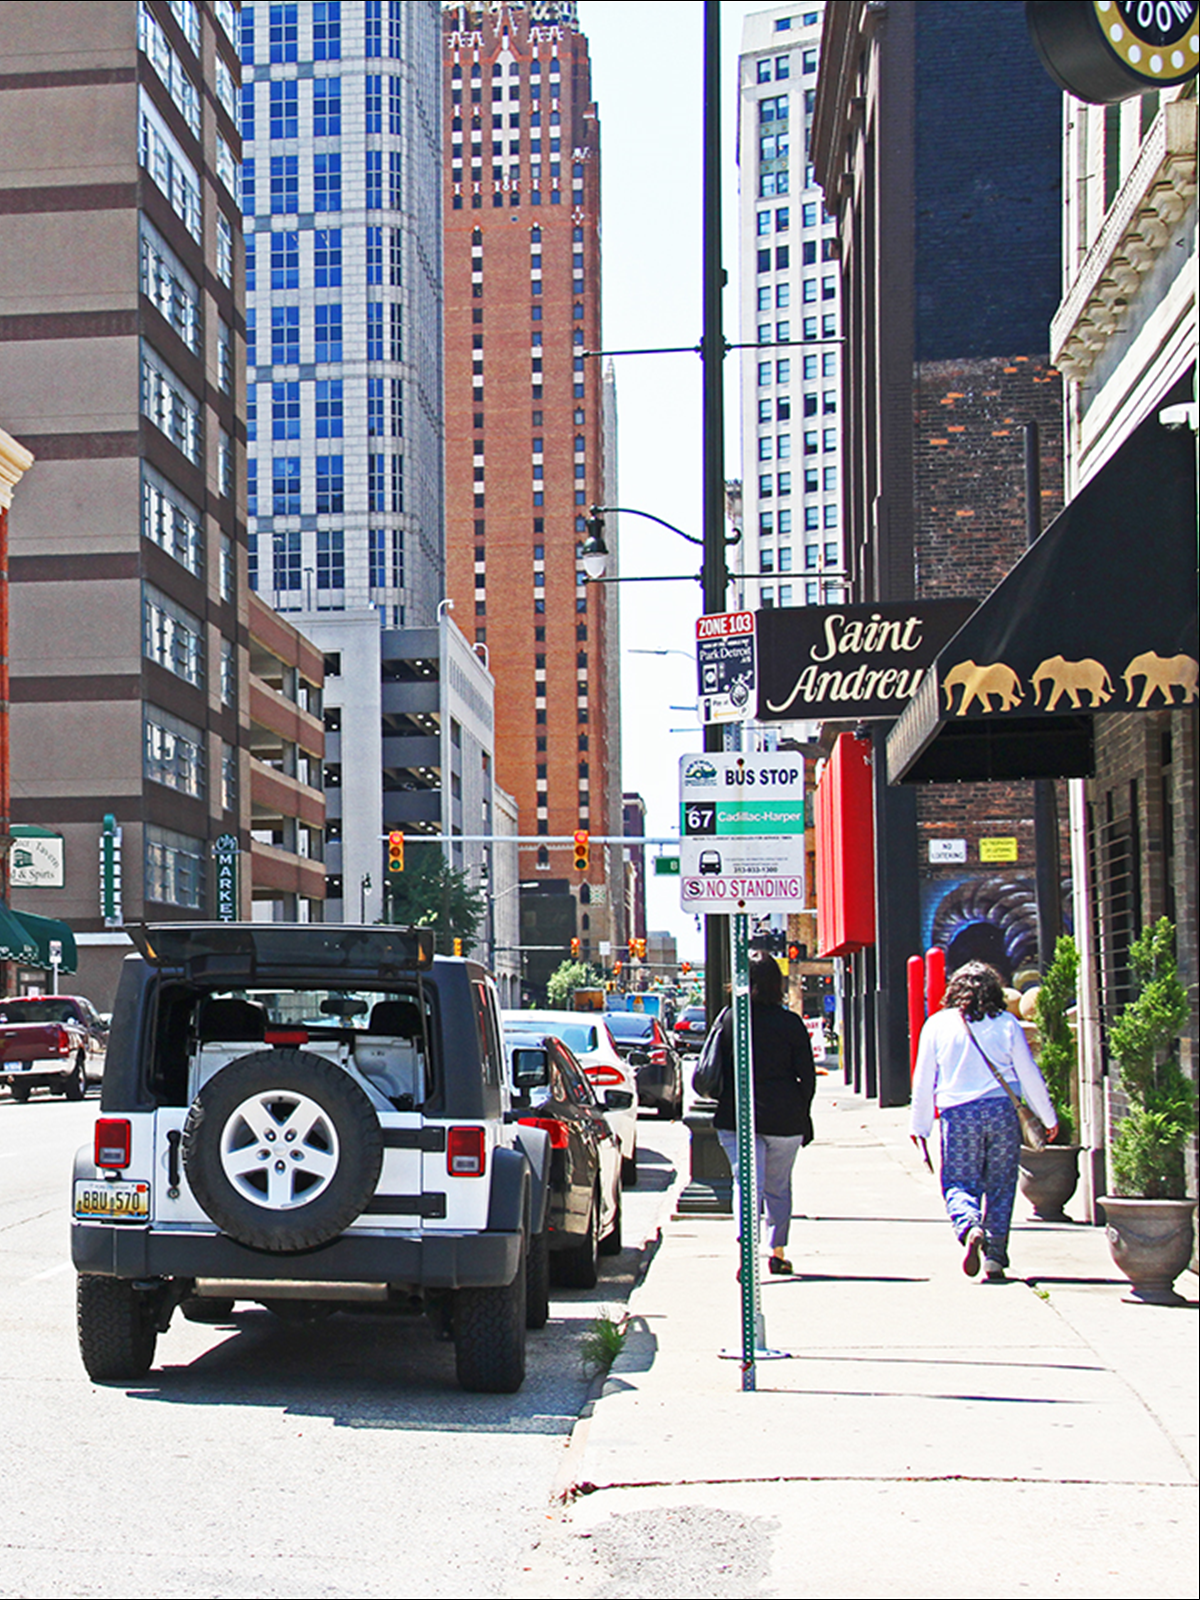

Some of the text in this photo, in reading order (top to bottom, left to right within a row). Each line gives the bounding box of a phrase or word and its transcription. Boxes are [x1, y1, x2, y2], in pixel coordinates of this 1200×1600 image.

[699, 613, 752, 637] ZONE 103
[810, 613, 923, 662] Saint
[725, 769, 755, 786] BUS
[759, 769, 799, 785] STOP
[687, 810, 714, 829] 67
[717, 811, 802, 823] Cadillac-Harper
[219, 854, 233, 923] MARKET
[706, 880, 726, 897] NO
[730, 879, 799, 897] STANDING
[115, 1191, 140, 1211] 570
